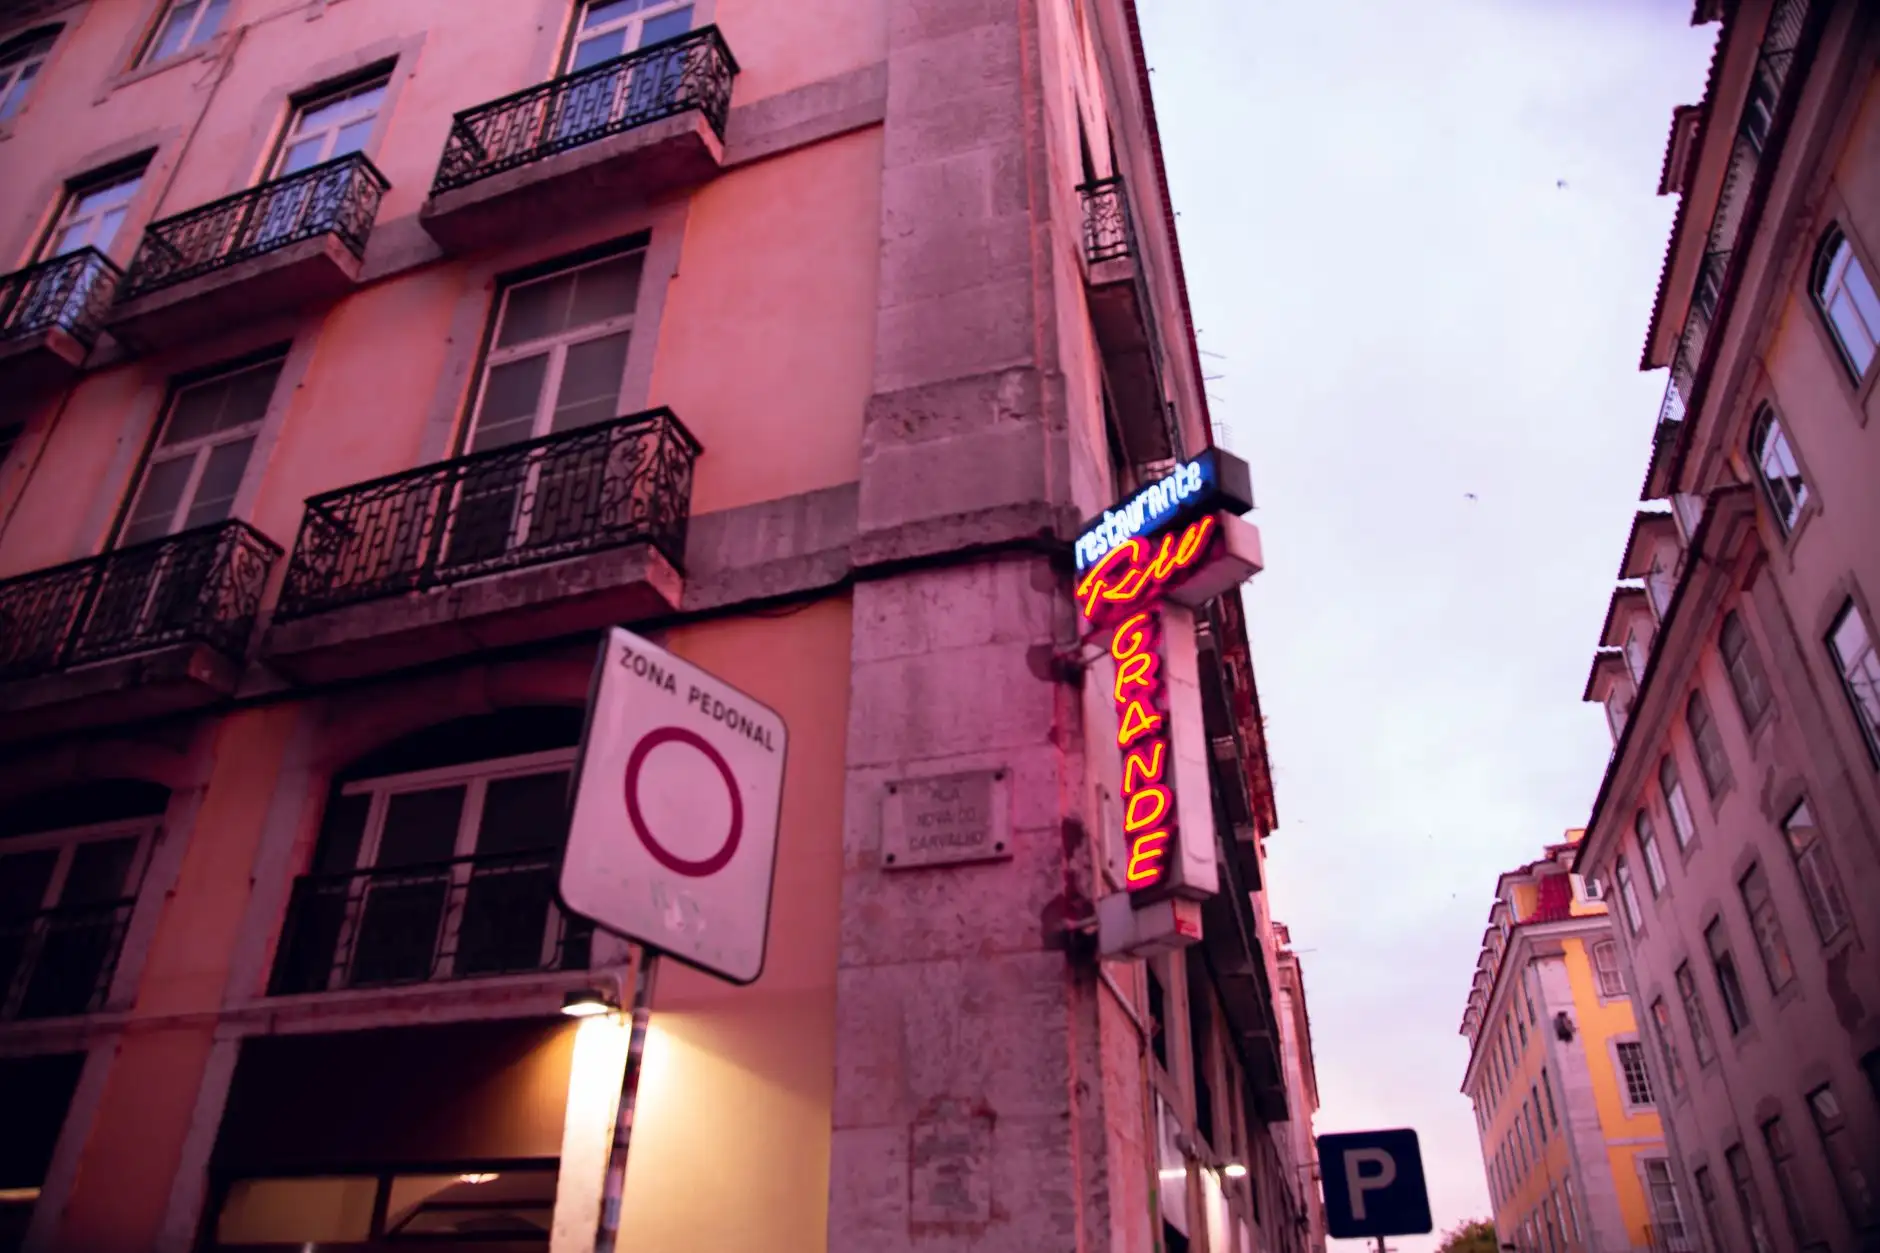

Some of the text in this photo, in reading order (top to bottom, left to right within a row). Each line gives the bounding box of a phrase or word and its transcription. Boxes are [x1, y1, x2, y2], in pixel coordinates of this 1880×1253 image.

[1075, 461, 1202, 570] restaurante
[620, 645, 775, 753] ZONA PEDONAL
[1110, 612, 1168, 883] GRANDE
[1343, 1147, 1397, 1221] P
